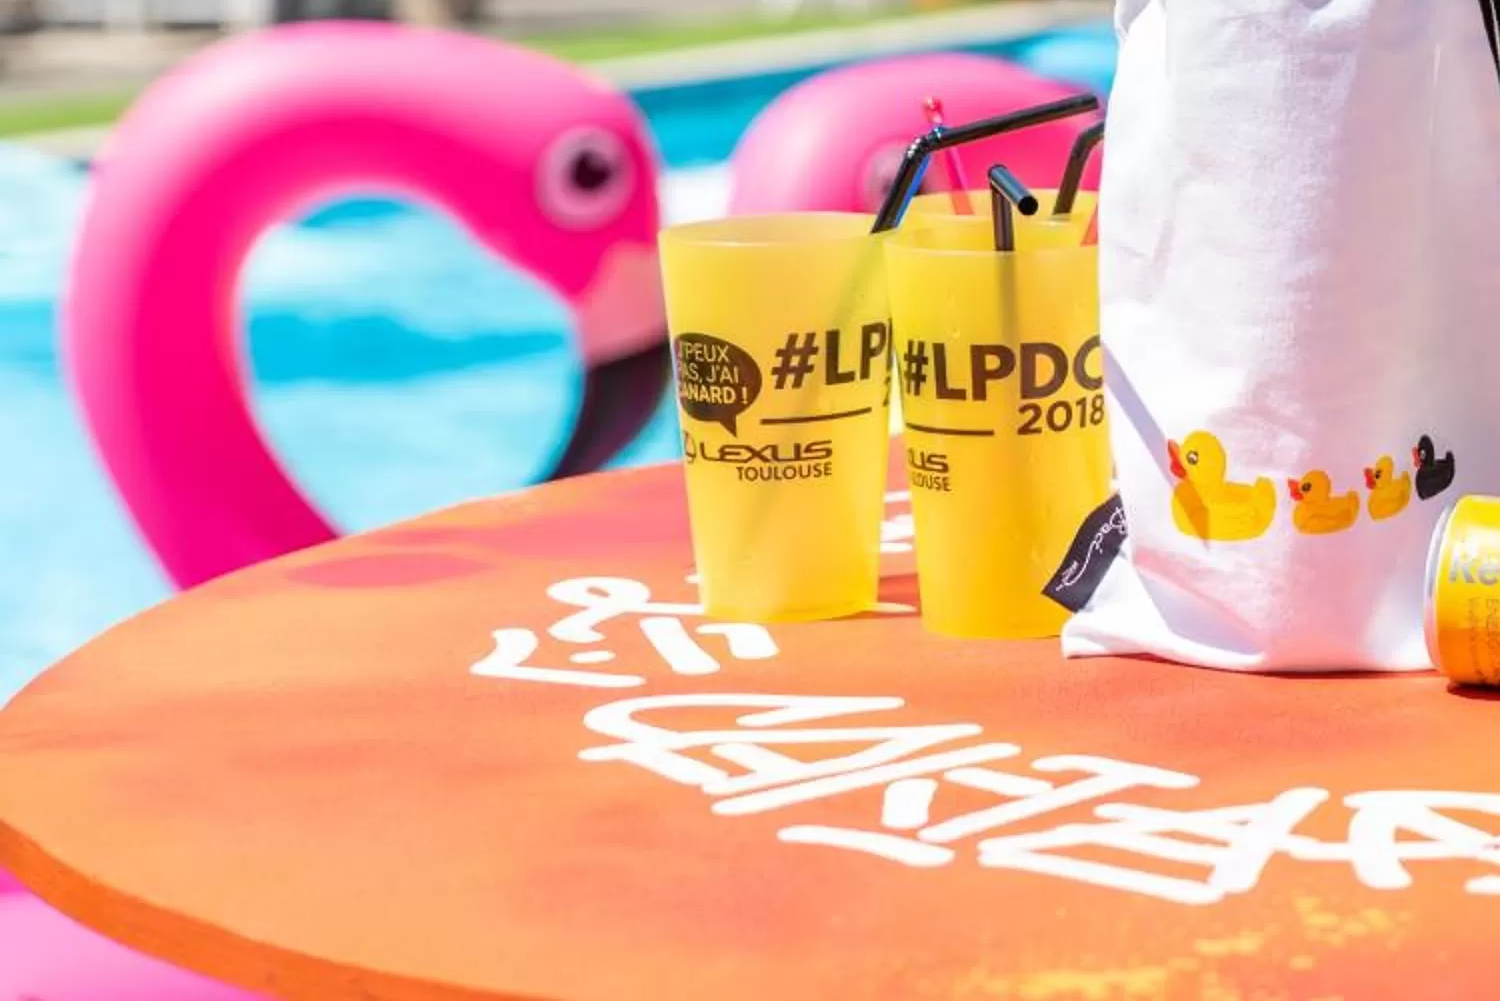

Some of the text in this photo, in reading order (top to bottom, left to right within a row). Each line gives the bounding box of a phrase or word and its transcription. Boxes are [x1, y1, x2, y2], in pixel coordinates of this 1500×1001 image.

[770, 317, 893, 390] #LP
[706, 364, 739, 384] J'AI
[1016, 394, 1105, 436] 2018
[700, 440, 833, 464] LEXUS
[736, 461, 833, 482] TOULOUSE
